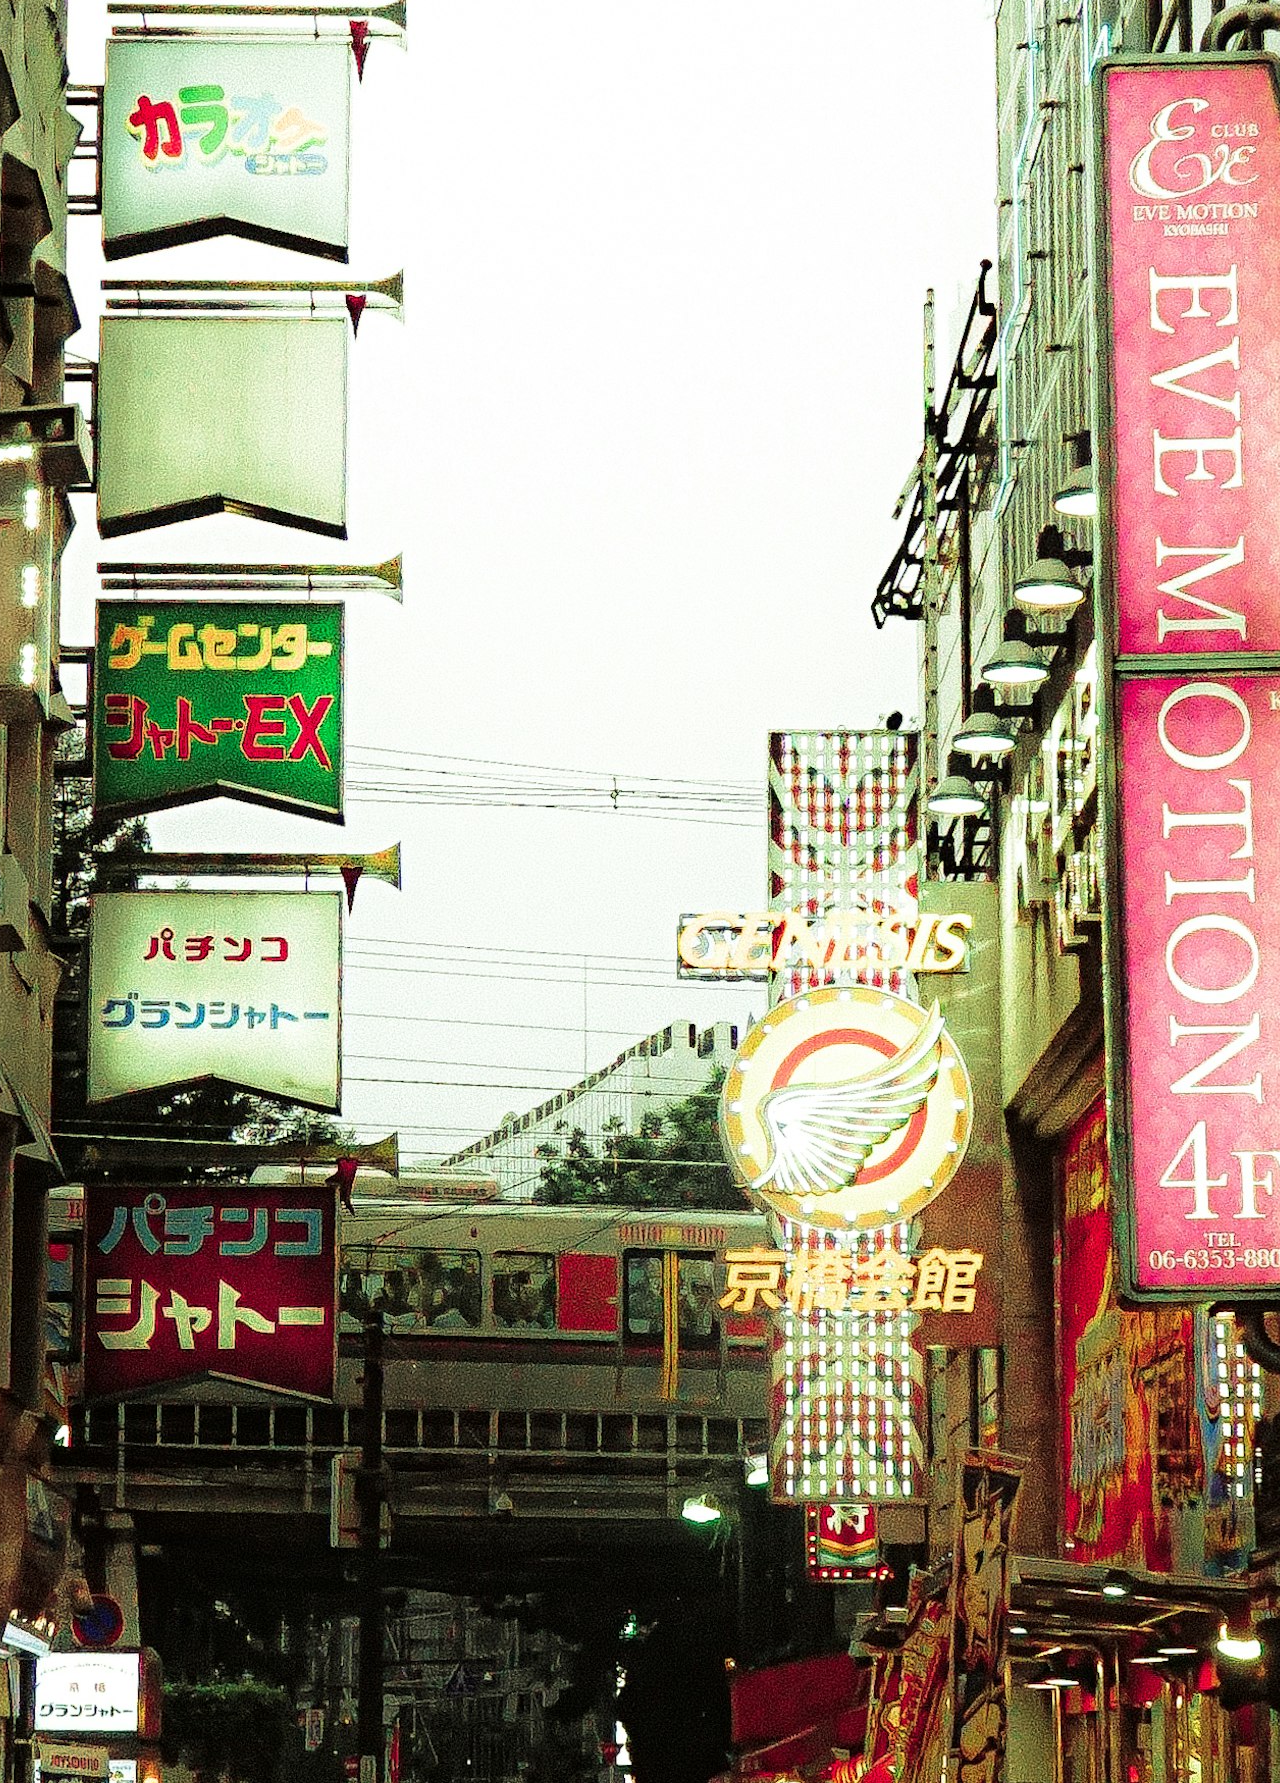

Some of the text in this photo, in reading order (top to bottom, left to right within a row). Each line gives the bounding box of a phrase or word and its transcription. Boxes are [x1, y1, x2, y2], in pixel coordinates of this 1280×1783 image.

[129, 84, 329, 162] カラオケ
[1210, 123, 1260, 138] CLUB
[1132, 201, 1259, 222] EVE MOTION
[1163, 223, 1229, 237] KYOBASHI
[1148, 263, 1246, 499] EVE
[107, 615, 334, 672] ゲームセンター
[143, 927, 290, 963] パチンコ
[677, 912, 973, 975] GENESIS
[101, 991, 331, 1030] グランシャトー
[96, 1192, 324, 1257] パチンコ
[1203, 1232, 1242, 1248] TEL
[717, 1247, 984, 1315] 京橋会館
[95, 1278, 326, 1351] シャトー
[39, 1701, 134, 1718] グランシャトー
